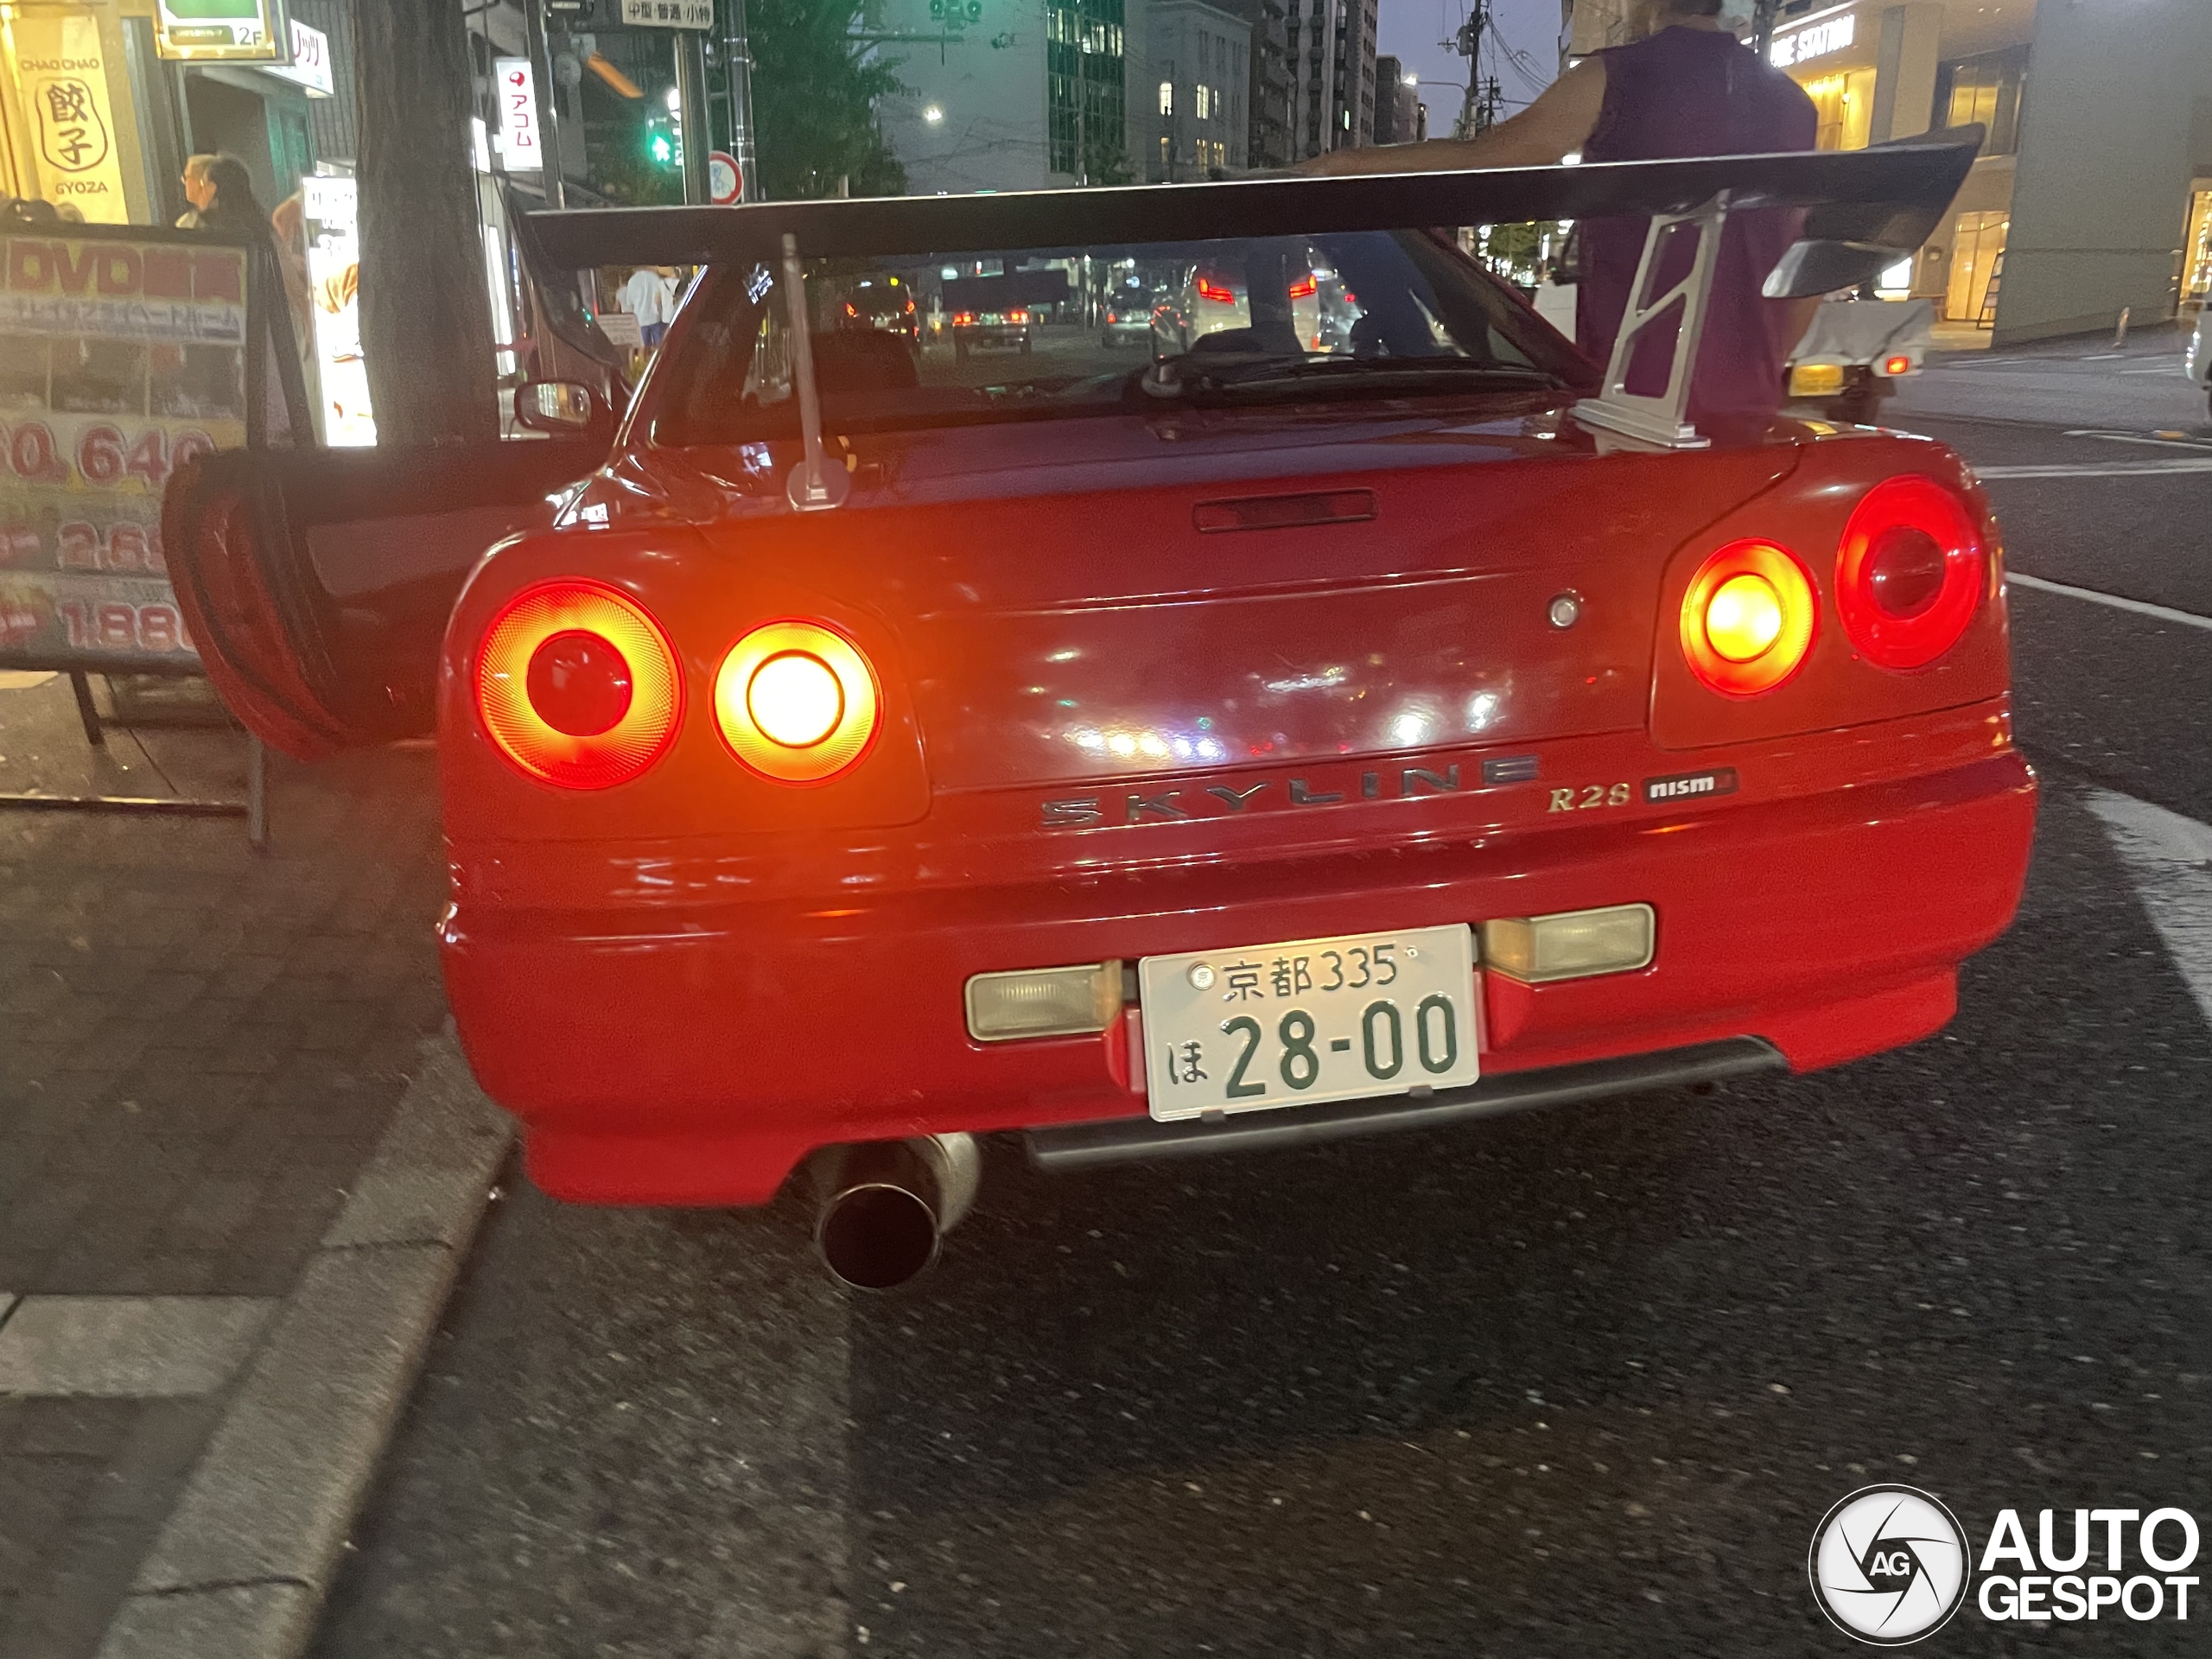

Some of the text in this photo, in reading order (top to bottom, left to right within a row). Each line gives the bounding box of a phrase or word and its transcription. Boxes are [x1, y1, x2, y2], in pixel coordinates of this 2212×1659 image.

[238, 27, 262, 46] 2F
[47, 83, 92, 165] 餃子
[512, 95, 531, 146] アコム
[55, 181, 109, 195] GYOZA
[1041, 754, 1538, 827] SKYLINE
[1548, 782, 1631, 814] R28
[1167, 991, 1458, 1099] ほ 28-00
